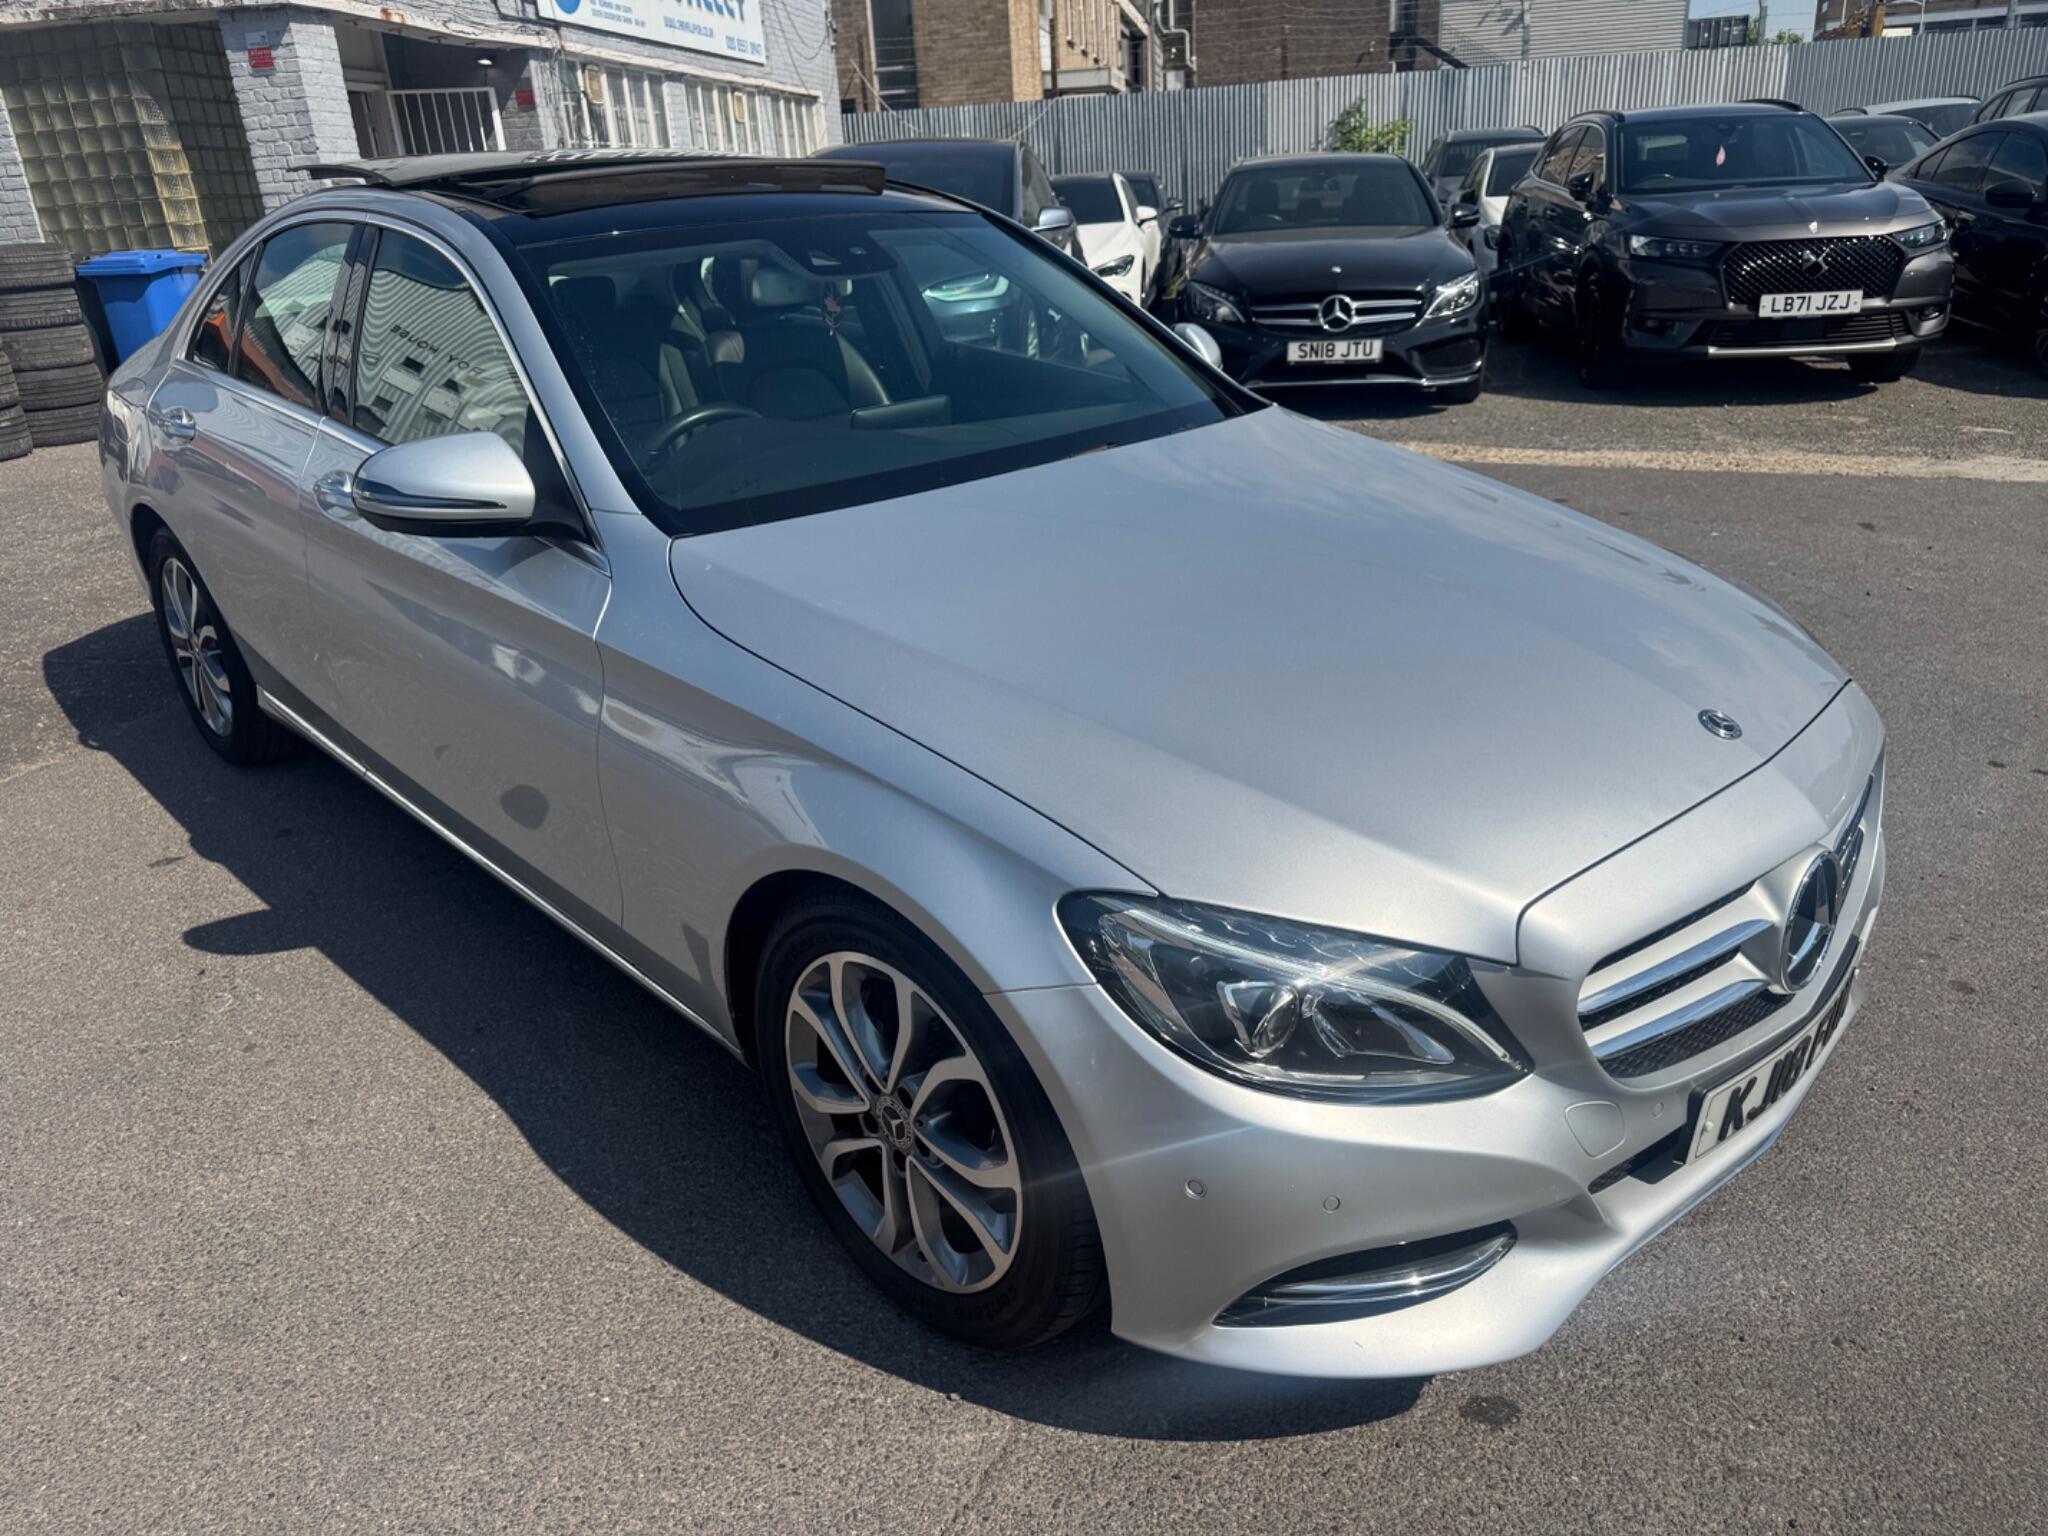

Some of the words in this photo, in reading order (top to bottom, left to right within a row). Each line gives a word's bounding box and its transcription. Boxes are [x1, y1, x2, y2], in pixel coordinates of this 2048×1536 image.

[1770, 295, 1812, 313] LB71
[1815, 293, 1851, 311] JZJ
[1298, 342, 1336, 359] SN18
[1340, 341, 1373, 358] JTU
